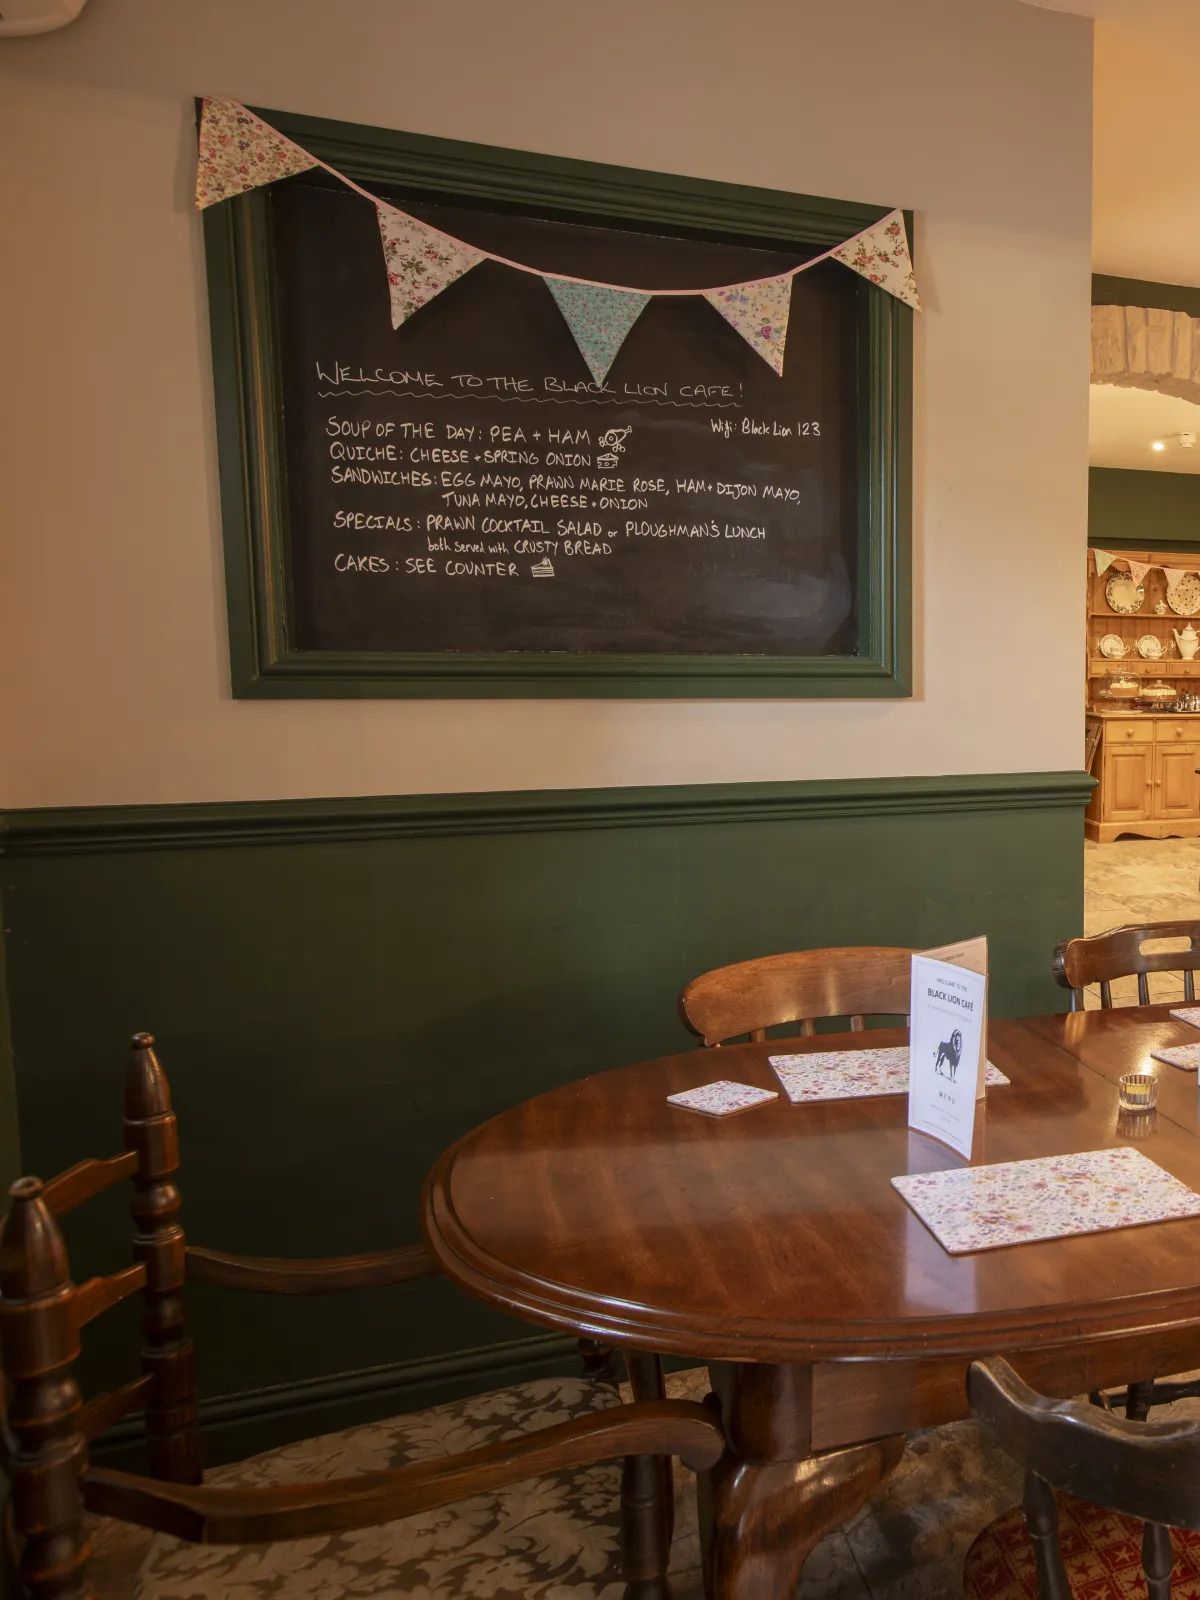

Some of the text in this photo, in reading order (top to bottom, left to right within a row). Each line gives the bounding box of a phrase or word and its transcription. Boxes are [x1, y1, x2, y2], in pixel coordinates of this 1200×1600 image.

[316, 362, 443, 386] WELCOME
[451, 375, 482, 388] TO
[486, 377, 533, 391] THE
[544, 377, 616, 394] BLACK
[625, 383, 667, 396] LION
[326, 416, 371, 437] SOUP
[376, 423, 396, 436] OF
[401, 423, 436, 439] THE
[446, 425, 483, 440] DAY:
[490, 426, 527, 442] PEA
[548, 429, 591, 445] HAM
[711, 417, 821, 438] Wifi: Black Lion 123
[330, 442, 403, 462] QUICHE:
[410, 449, 469, 464] CHEESE
[484, 451, 540, 466] SPRING
[546, 451, 591, 467] ONION
[331, 466, 437, 487] SANDWICHES:
[441, 472, 476, 487] EGG
[480, 473, 524, 492] MAYO,
[529, 475, 574, 490] PRAWN
[580, 478, 626, 492] MARIE
[633, 479, 670, 496] ROSE,
[676, 479, 706, 494] HAM
[717, 483, 757, 499] DIJON
[763, 486, 801, 505] MAYO,
[442, 491, 481, 507] TUNA
[486, 493, 529, 509] MAYO,
[531, 495, 588, 509] CHEESE
[600, 497, 649, 511] ONION
[427, 515, 476, 532] PRAWN
[482, 516, 551, 534] COCKTAIL
[557, 519, 602, 537] SALAD
[608, 530, 618, 538] or
[626, 520, 721, 538] PLOUGHMAN'S
[725, 524, 766, 540] LUNCH
[427, 536, 612, 556] both served with CRUSTY BREAD
[406, 558, 437, 574] SEE
[445, 561, 520, 577] COUNTER
[928, 988, 974, 1012] BLACK LION CAFÉ
